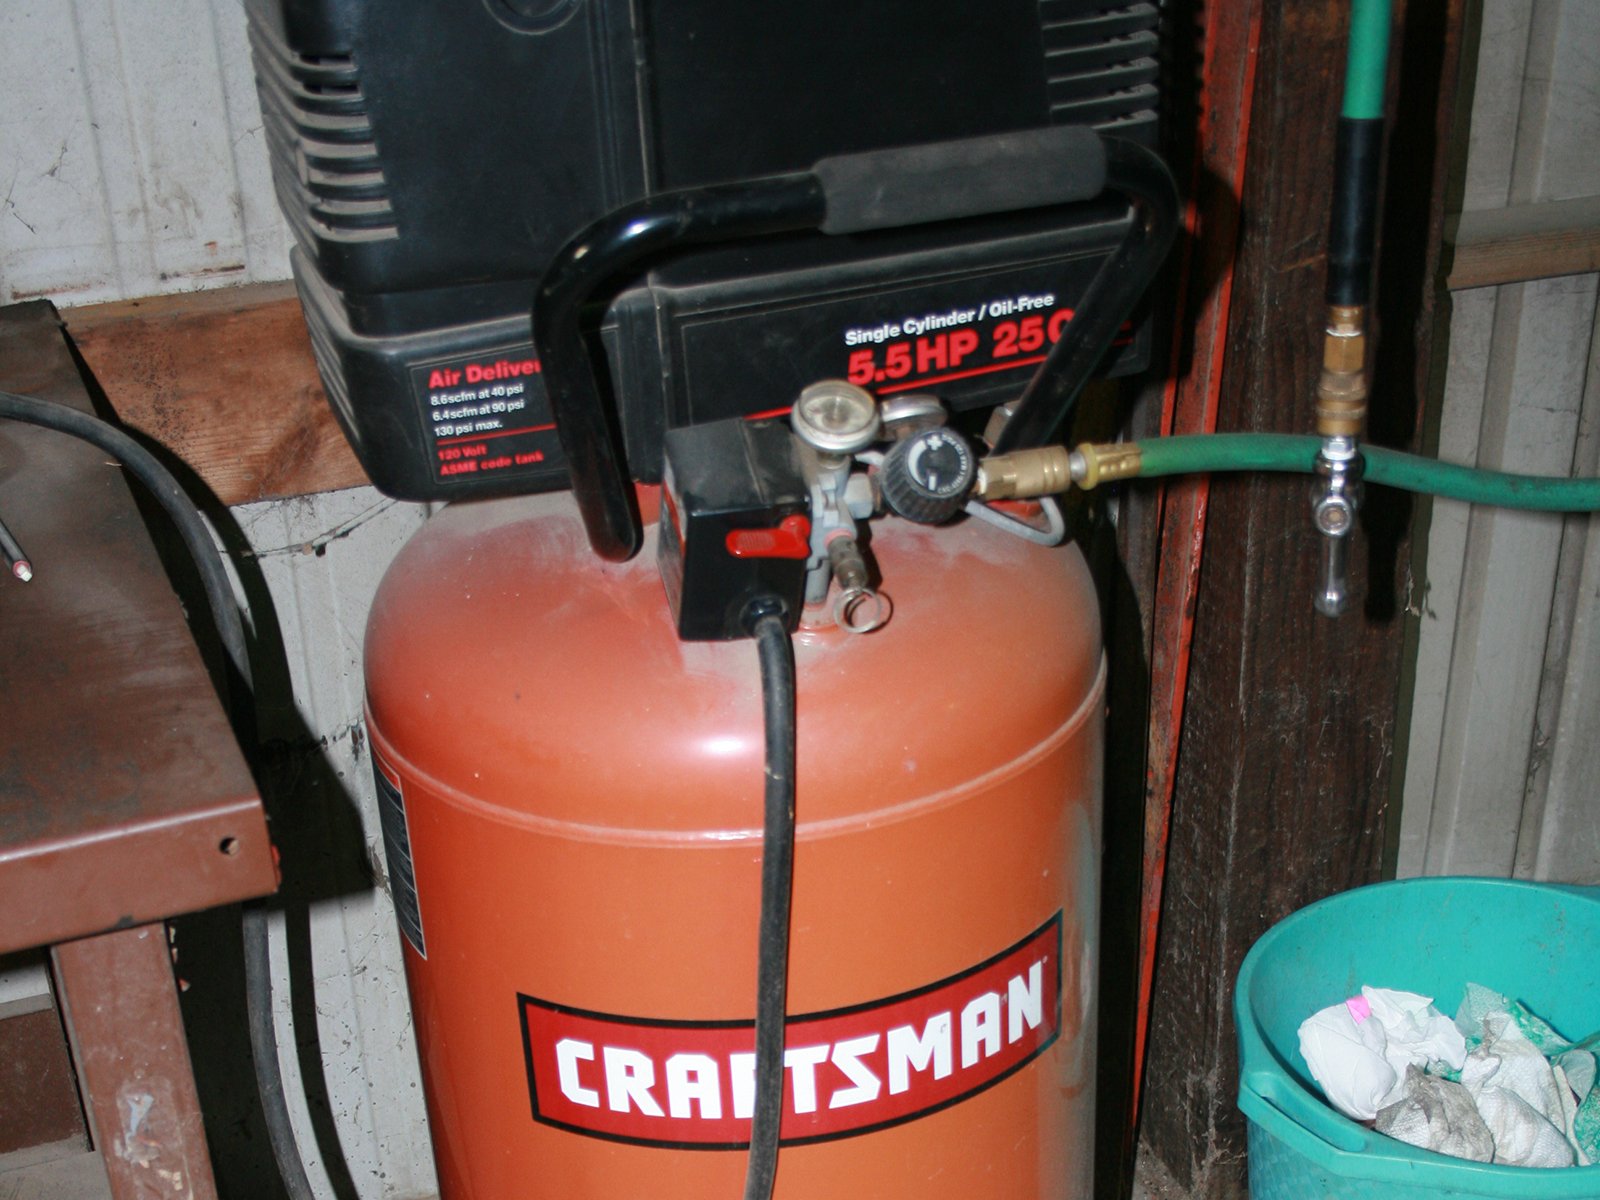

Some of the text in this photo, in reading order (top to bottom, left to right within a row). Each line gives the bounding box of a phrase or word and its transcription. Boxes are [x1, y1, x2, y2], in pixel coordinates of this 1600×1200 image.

[845, 324, 900, 346] Single
[903, 310, 976, 335] Cylinder
[989, 294, 1055, 317] Oil-Free
[428, 359, 542, 389] Air Deliver
[478, 388, 490, 400] at
[491, 385, 505, 397] 40
[507, 383, 524, 397] psi
[479, 404, 491, 415] at
[492, 402, 505, 413] 90
[508, 399, 525, 413] psi
[434, 420, 503, 437] 130 psi max.
[437, 443, 487, 460] 120 Volt
[440, 450, 545, 476] ASME code tank
